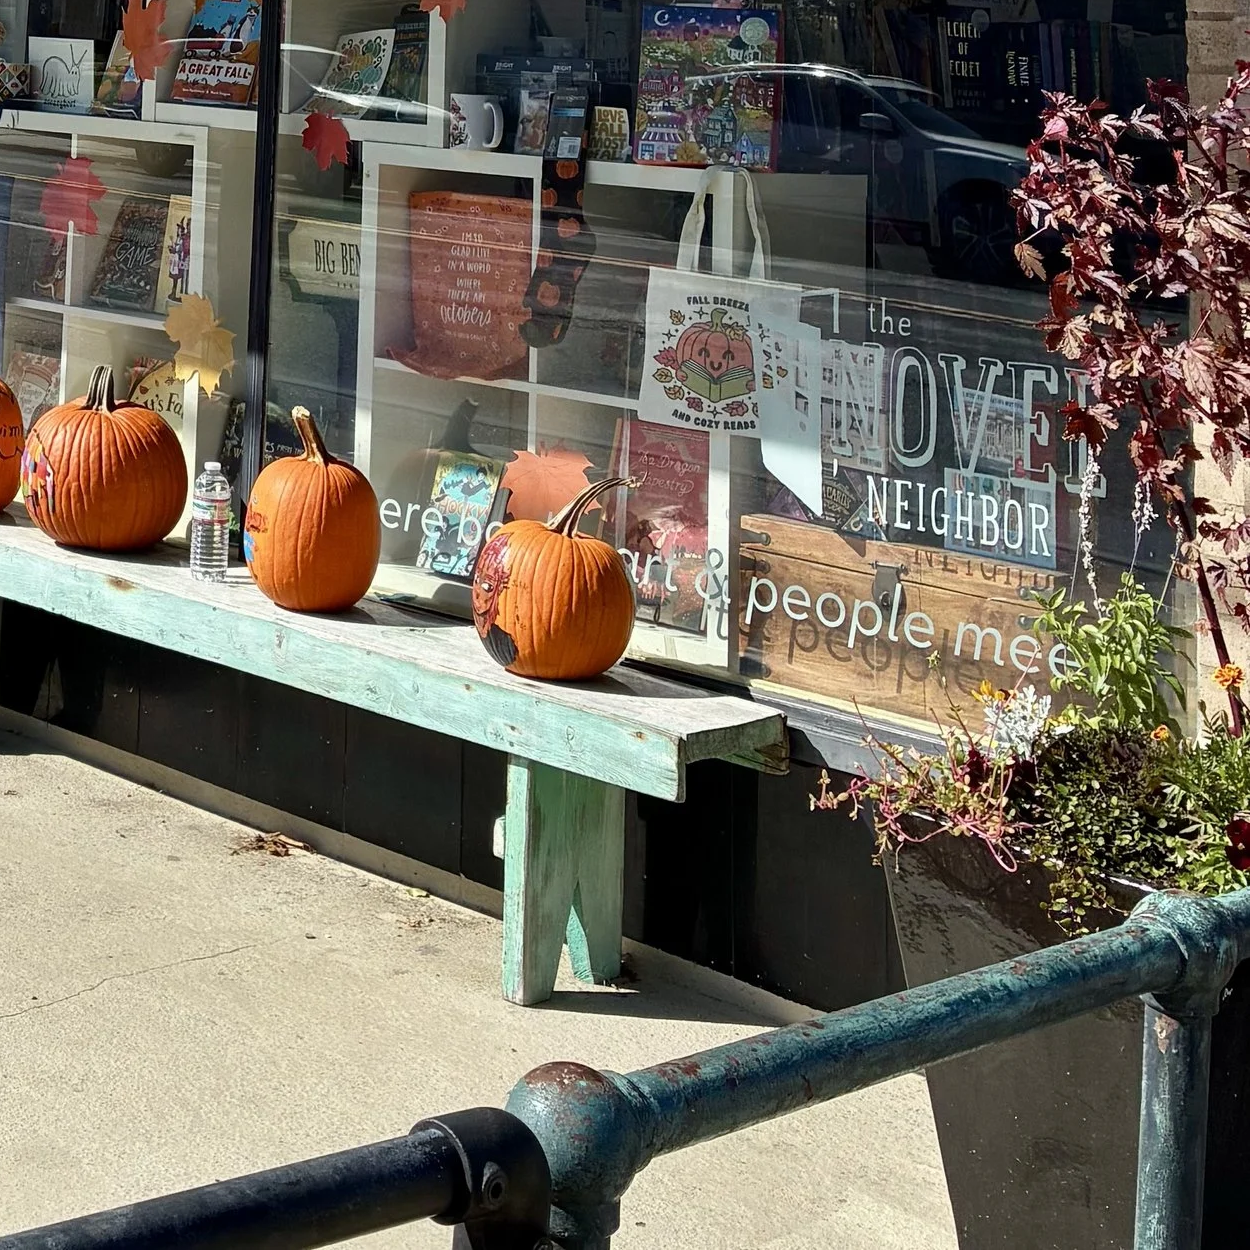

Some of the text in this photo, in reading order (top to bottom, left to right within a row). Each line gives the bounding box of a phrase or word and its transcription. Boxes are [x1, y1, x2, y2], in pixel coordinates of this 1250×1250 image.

[958, 42, 969, 55] OF
[179, 63, 249, 80] A GREAT FALL
[949, 59, 981, 78] ECRET
[115, 242, 155, 268] GAME
[314, 239, 336, 274] BIG
[456, 277, 481, 290] WHERE
[687, 296, 710, 305] FALL
[867, 297, 912, 337] the
[166, 392, 184, 419] Fa
[828, 338, 1108, 499] NOVEL
[671, 409, 756, 430] AND COZY READS
[657, 454, 701, 475] Dragon
[638, 470, 695, 497] Tapestry
[866, 475, 1052, 558] NEIGHBOR
[379, 498, 444, 538] ere
[617, 546, 679, 593] art
[745, 577, 935, 650] people
[954, 621, 1082, 678] mee
